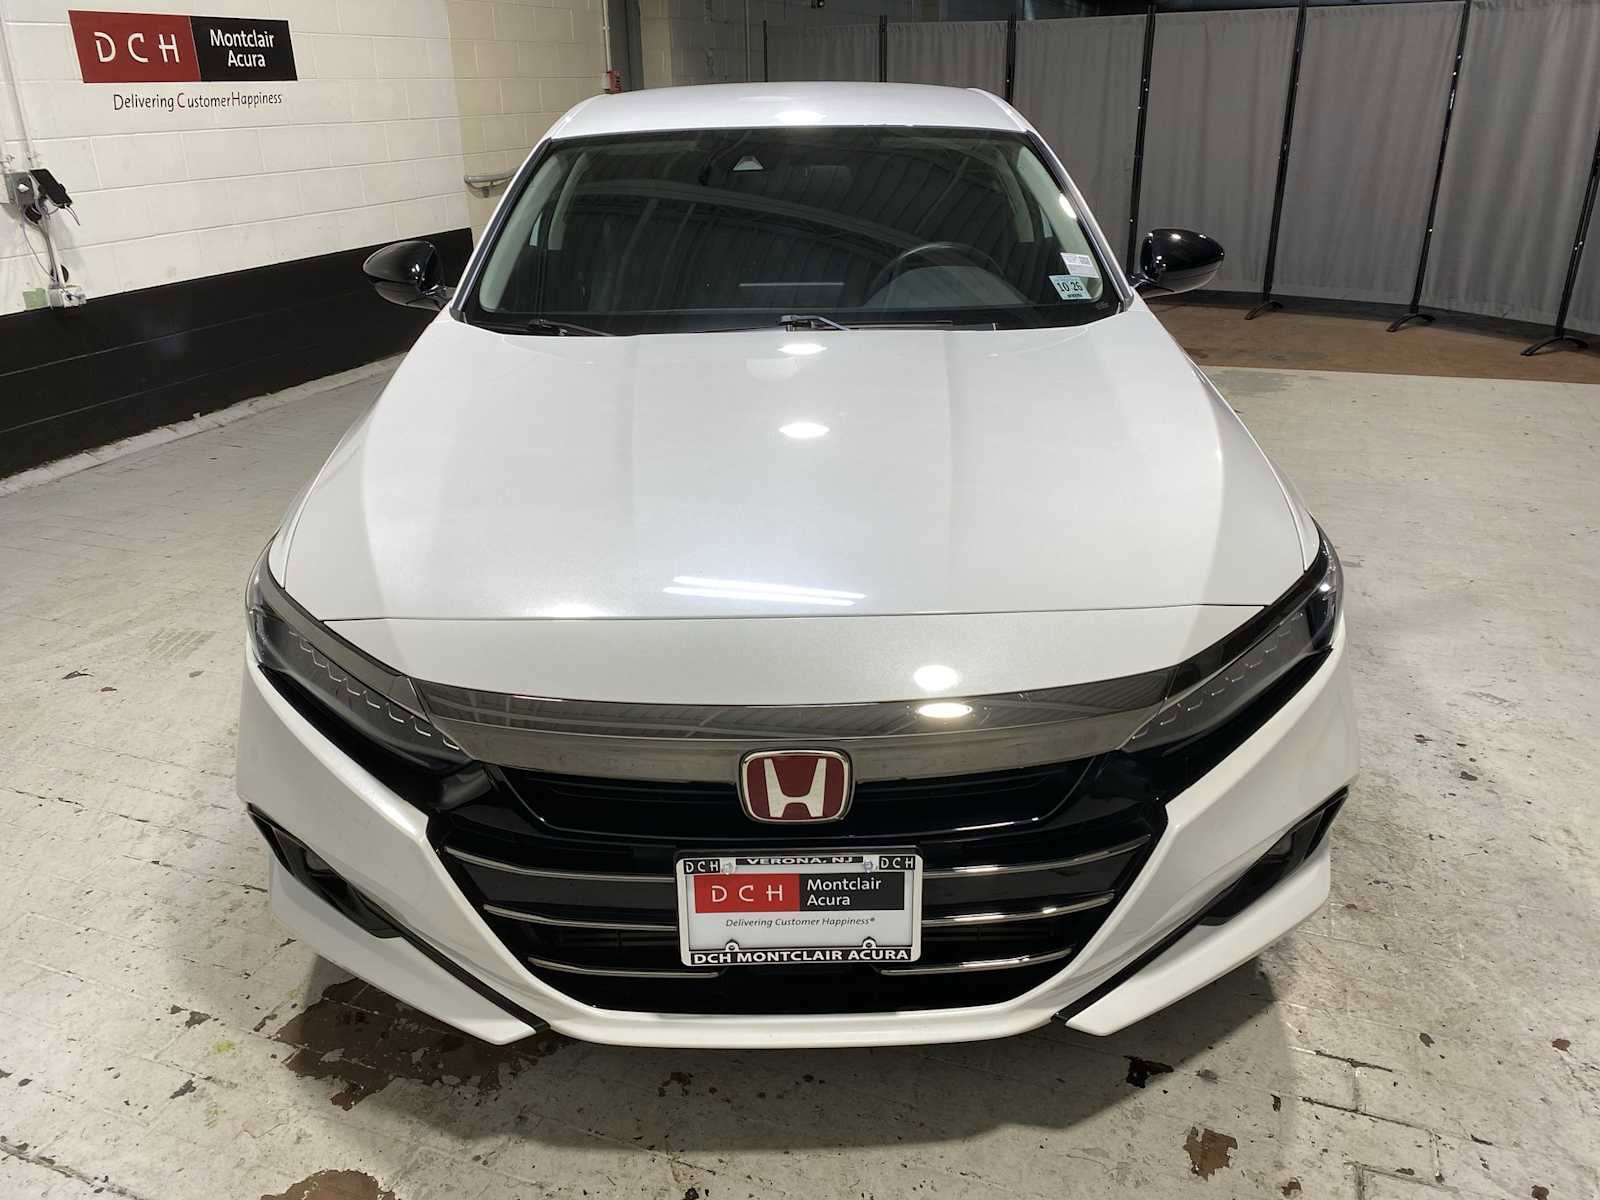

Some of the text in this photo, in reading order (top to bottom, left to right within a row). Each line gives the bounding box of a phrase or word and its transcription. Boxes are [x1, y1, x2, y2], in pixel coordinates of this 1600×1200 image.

[209, 28, 275, 48] Montclair
[227, 49, 266, 68] Acura
[113, 93, 175, 112] Delivering
[1057, 281, 1070, 292] 10
[831, 856, 853, 864] NJ
[880, 857, 914, 869] DCH
[685, 861, 719, 873] DCH
[807, 877, 882, 892] Montclair
[807, 894, 851, 906] Acura
[726, 918, 773, 928] Delivering
[775, 917, 820, 926] Customer
[694, 949, 909, 964] DCH MONTCLAIR ACURA
